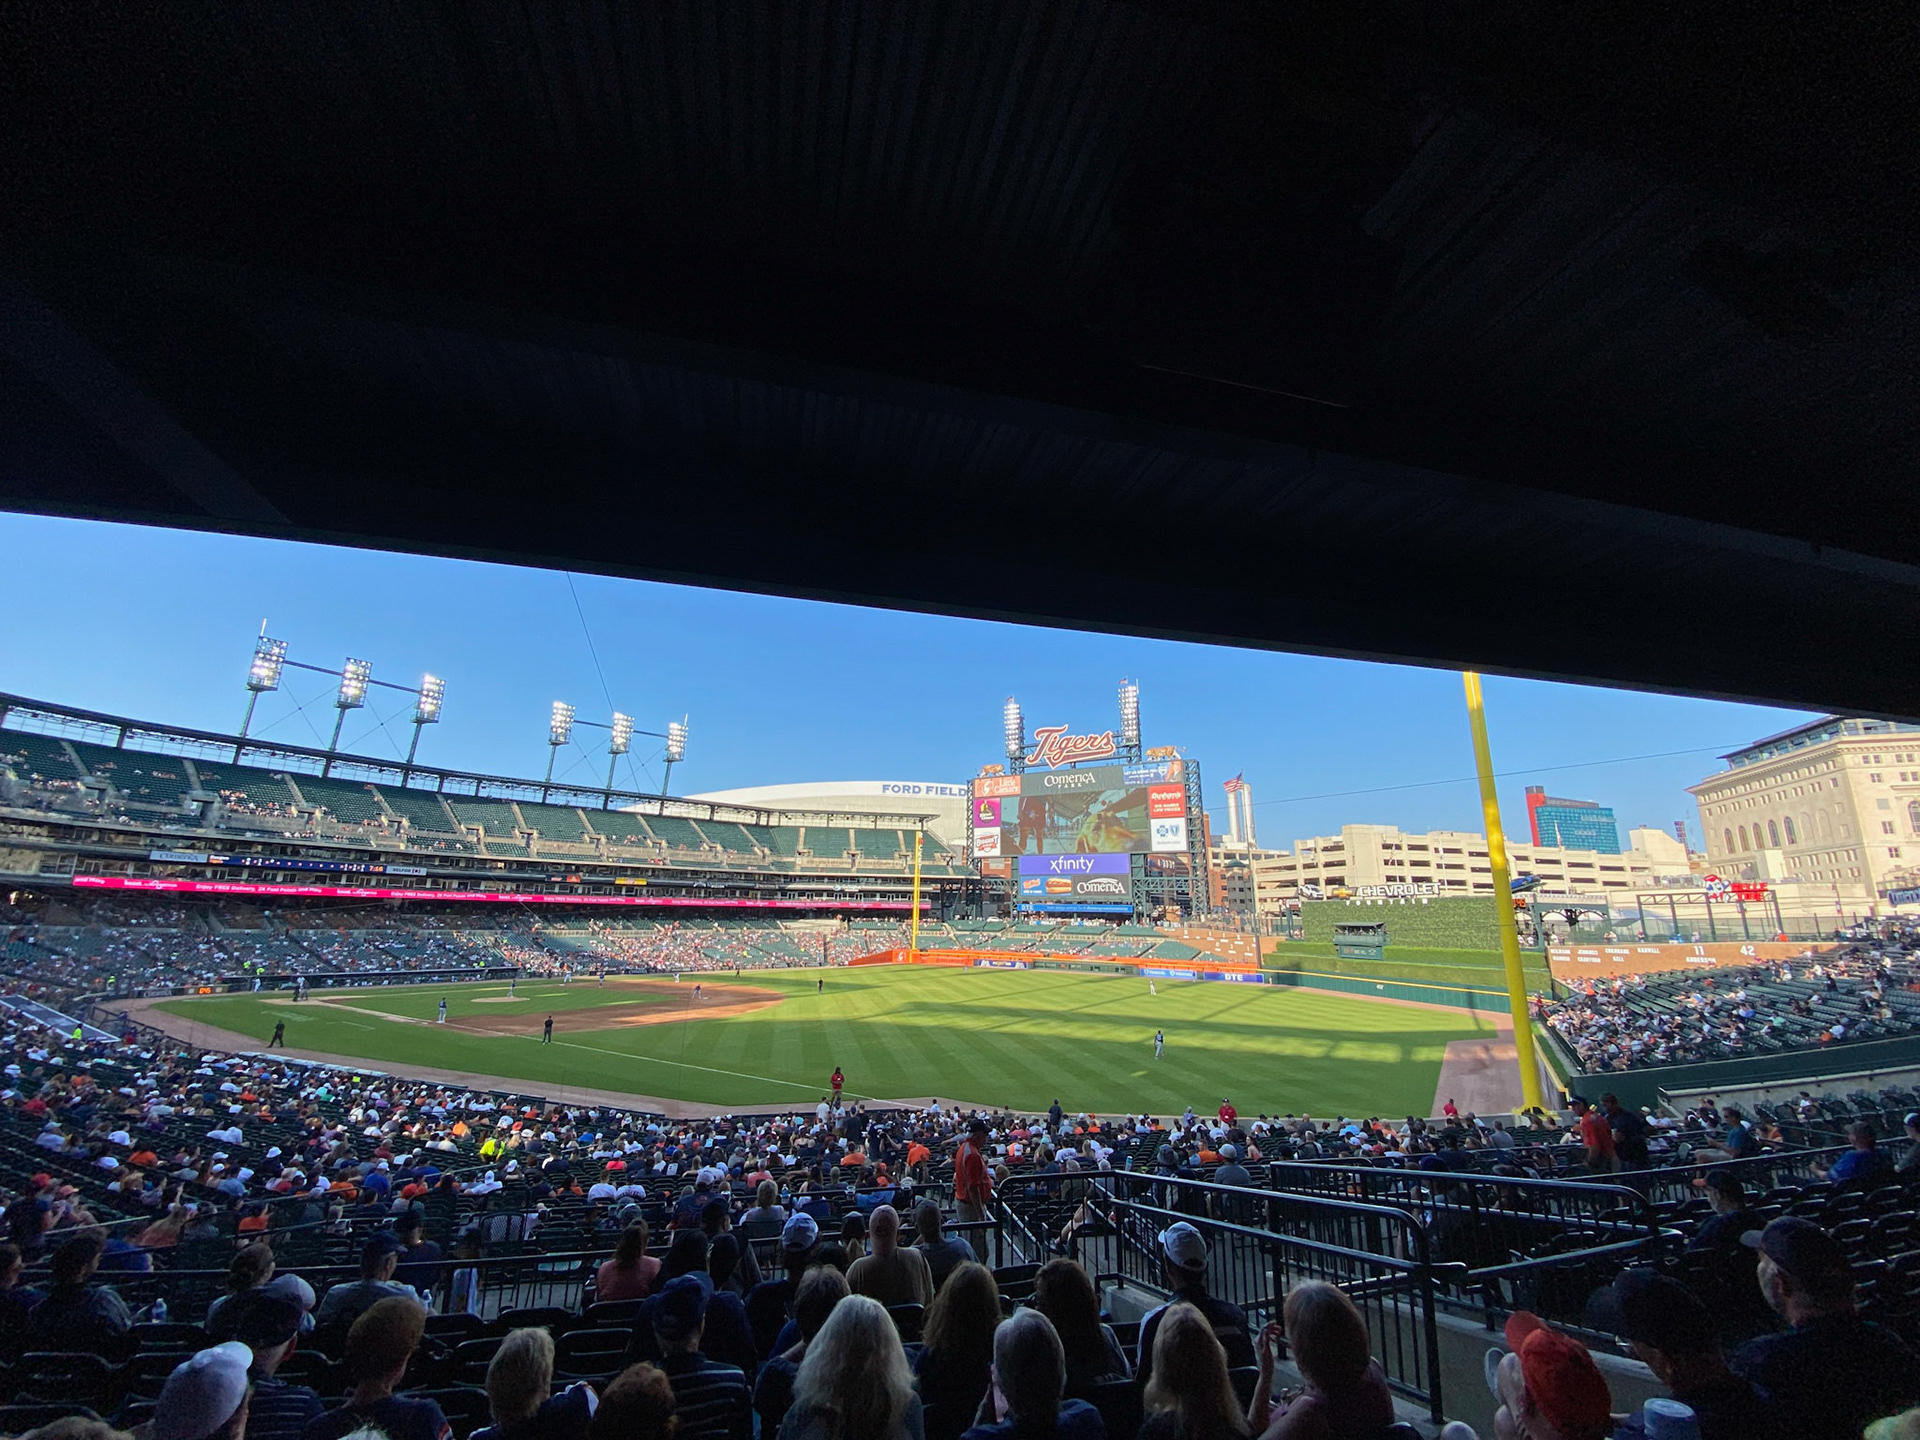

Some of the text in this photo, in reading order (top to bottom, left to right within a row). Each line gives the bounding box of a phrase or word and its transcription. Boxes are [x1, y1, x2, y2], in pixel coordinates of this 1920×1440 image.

[1026, 724, 1116, 770] Tigers
[882, 784, 968, 797] FORD FIELD
[1050, 856, 1094, 873] xfinity
[1358, 882, 1441, 897] CHEVROLET
[1730, 882, 1768, 892] BELLE
[1736, 892, 1764, 901] TIRE
[1693, 946, 1755, 956] 11 42
